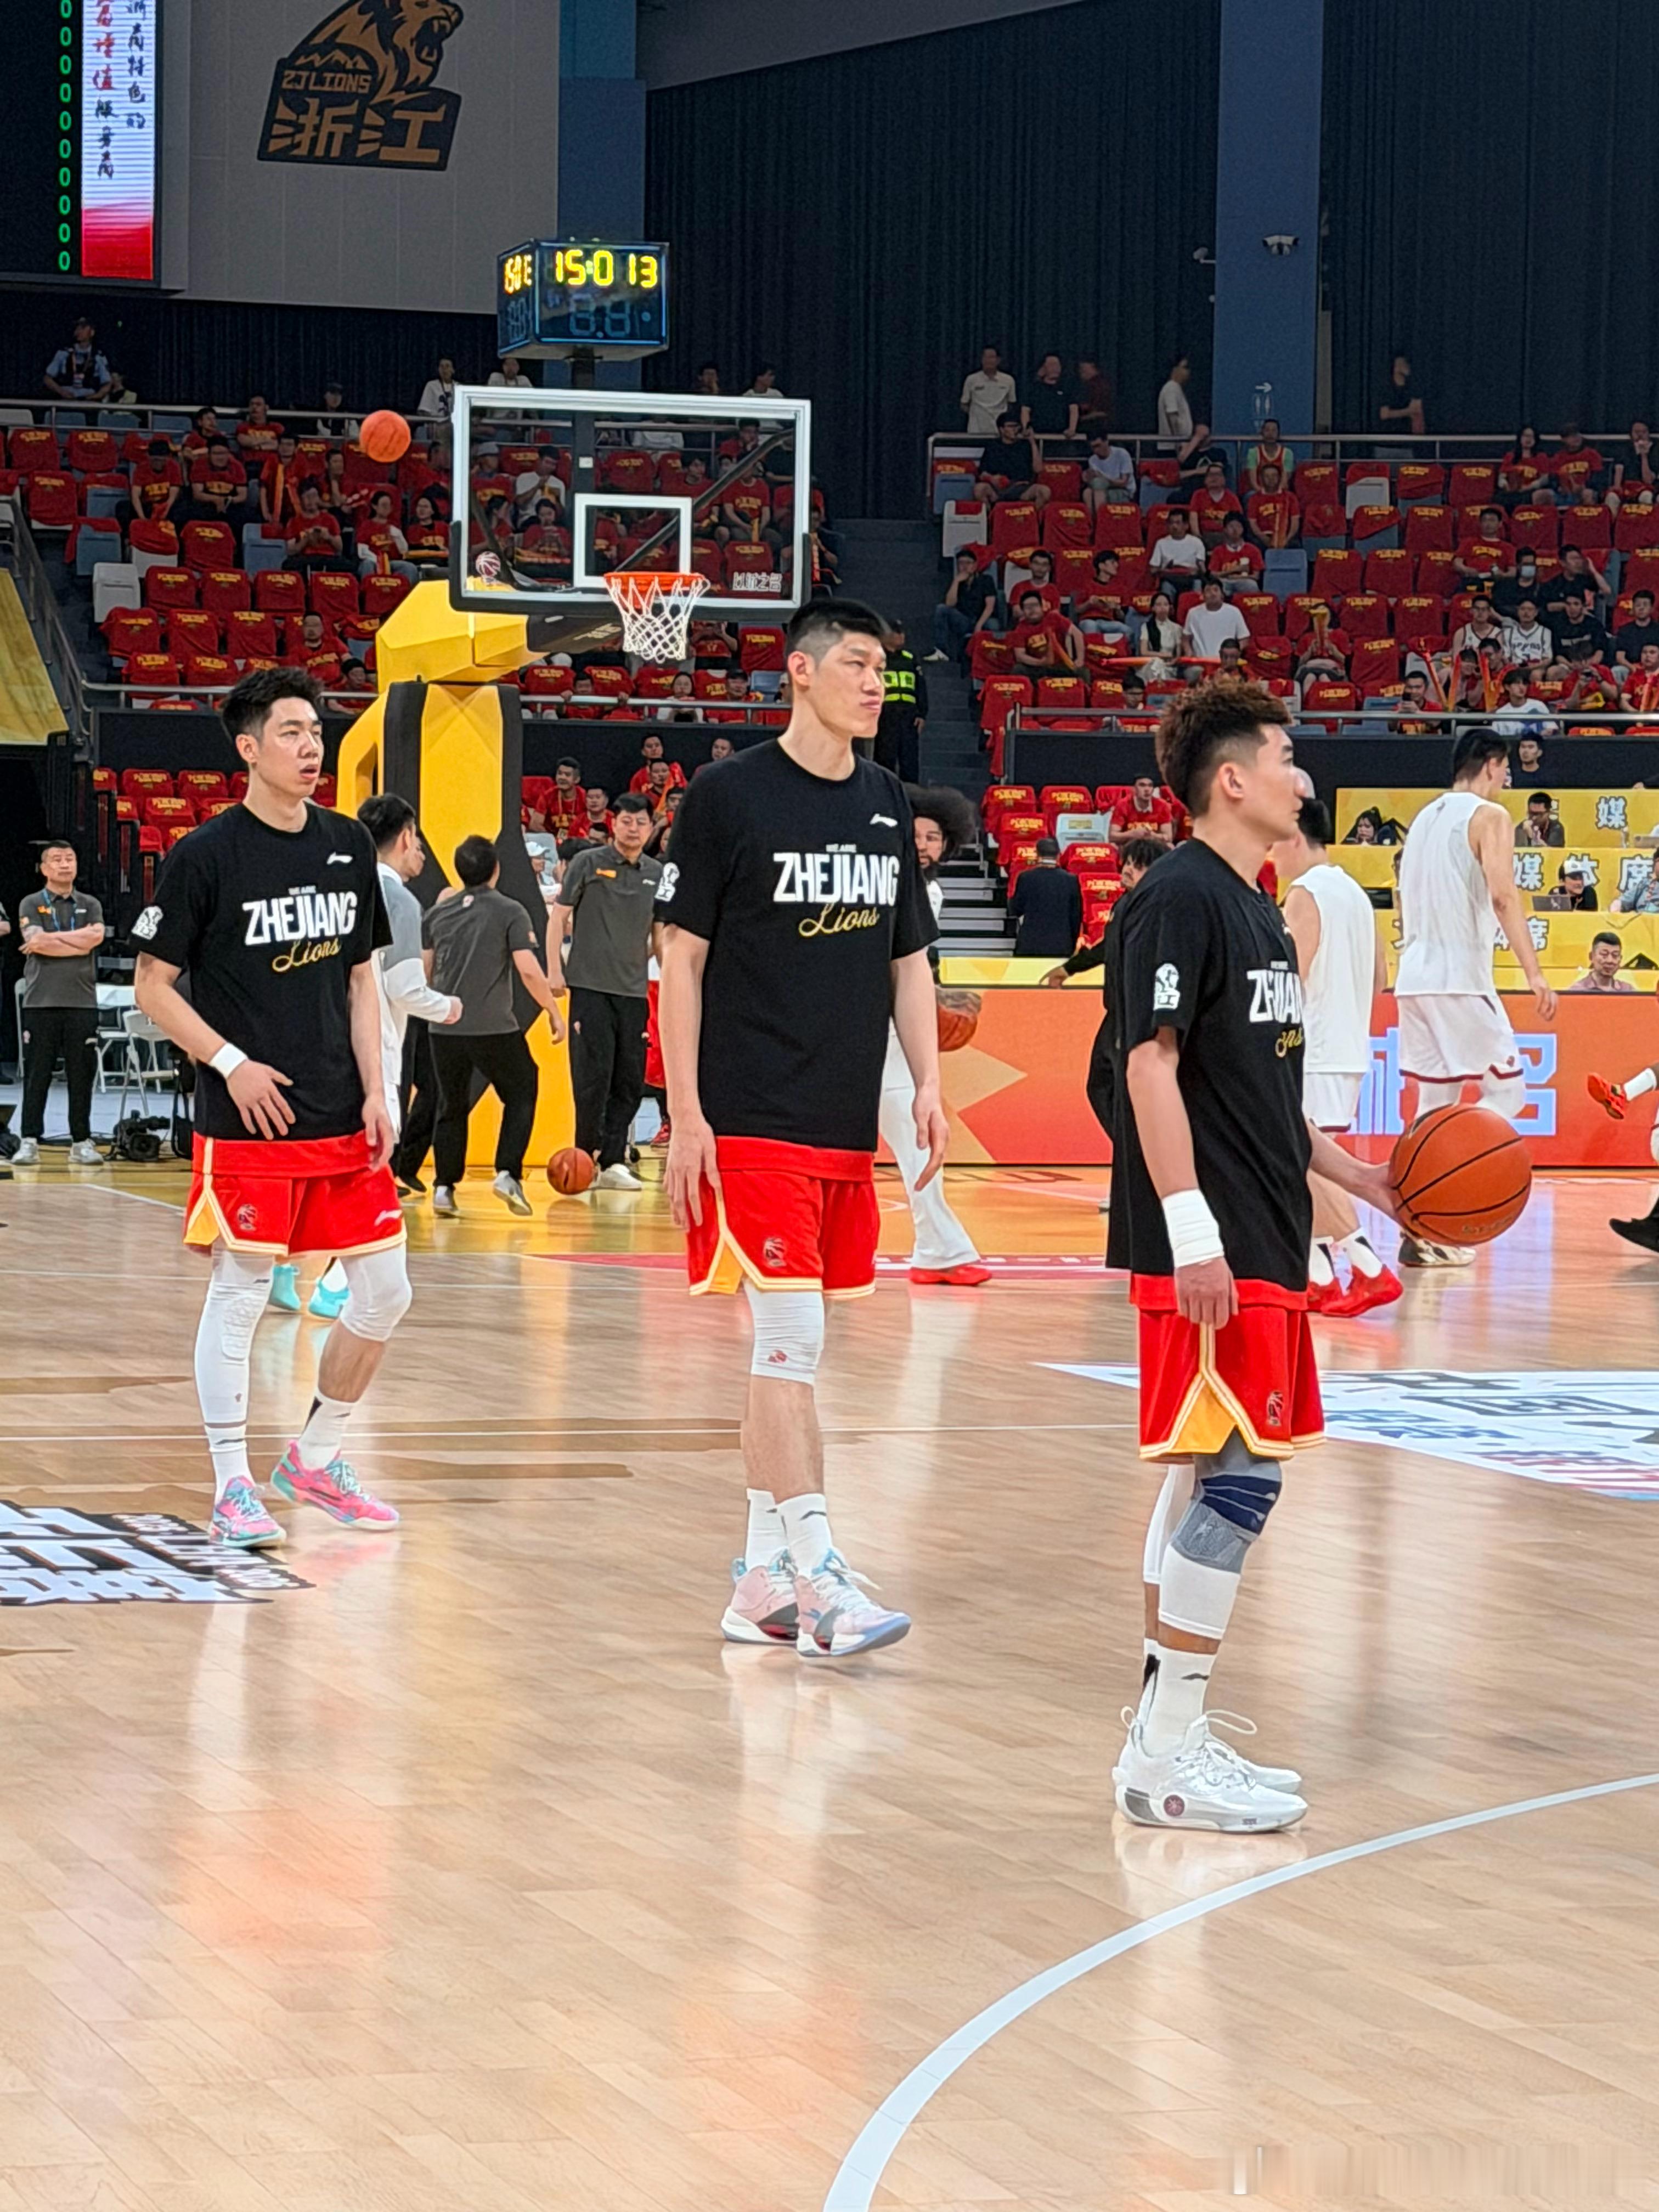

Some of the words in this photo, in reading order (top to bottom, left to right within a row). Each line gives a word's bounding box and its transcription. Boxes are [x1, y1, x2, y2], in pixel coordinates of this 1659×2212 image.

[61, 0, 72, 18] 0
[60, 27, 71, 46] 0
[60, 55, 71, 74] 0
[60, 83, 71, 102] 0
[60, 111, 71, 130] 0
[268, 96, 446, 163] 浙江
[60, 139, 71, 158] 0
[60, 168, 70, 187] 0
[59, 195, 70, 215] 0
[59, 223, 70, 242] 0
[59, 251, 70, 270] 0
[773, 852, 900, 906] ZHEJIANG
[242, 891, 358, 946] ZHEJIANG
[798, 902, 880, 937] Lions
[272, 938, 341, 972] Lions
